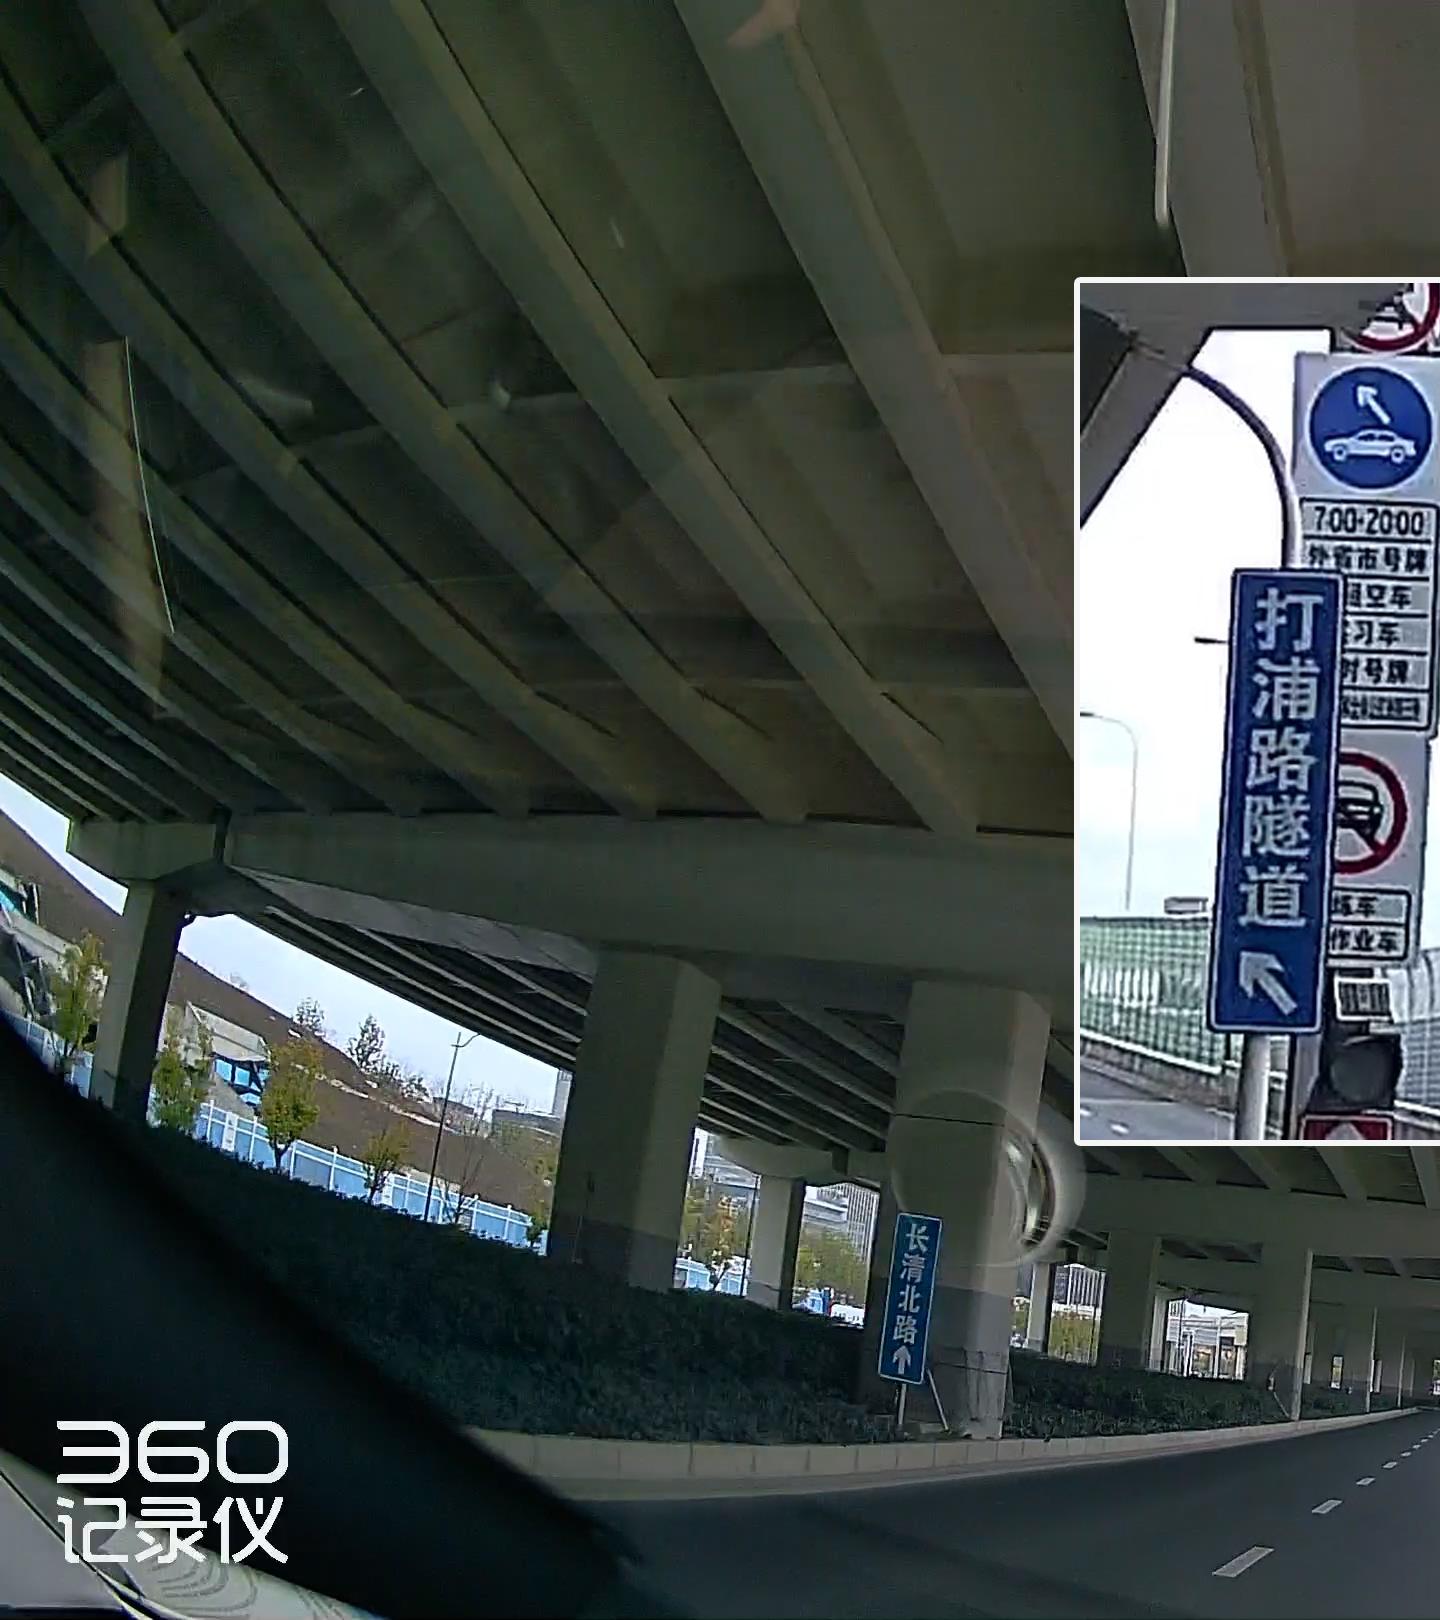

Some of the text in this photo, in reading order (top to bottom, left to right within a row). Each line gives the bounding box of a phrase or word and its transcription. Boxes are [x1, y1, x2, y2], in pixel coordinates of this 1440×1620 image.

[1239, 587, 1323, 927] 打浦路隧道
[893, 1223, 929, 1345] 长清北路
